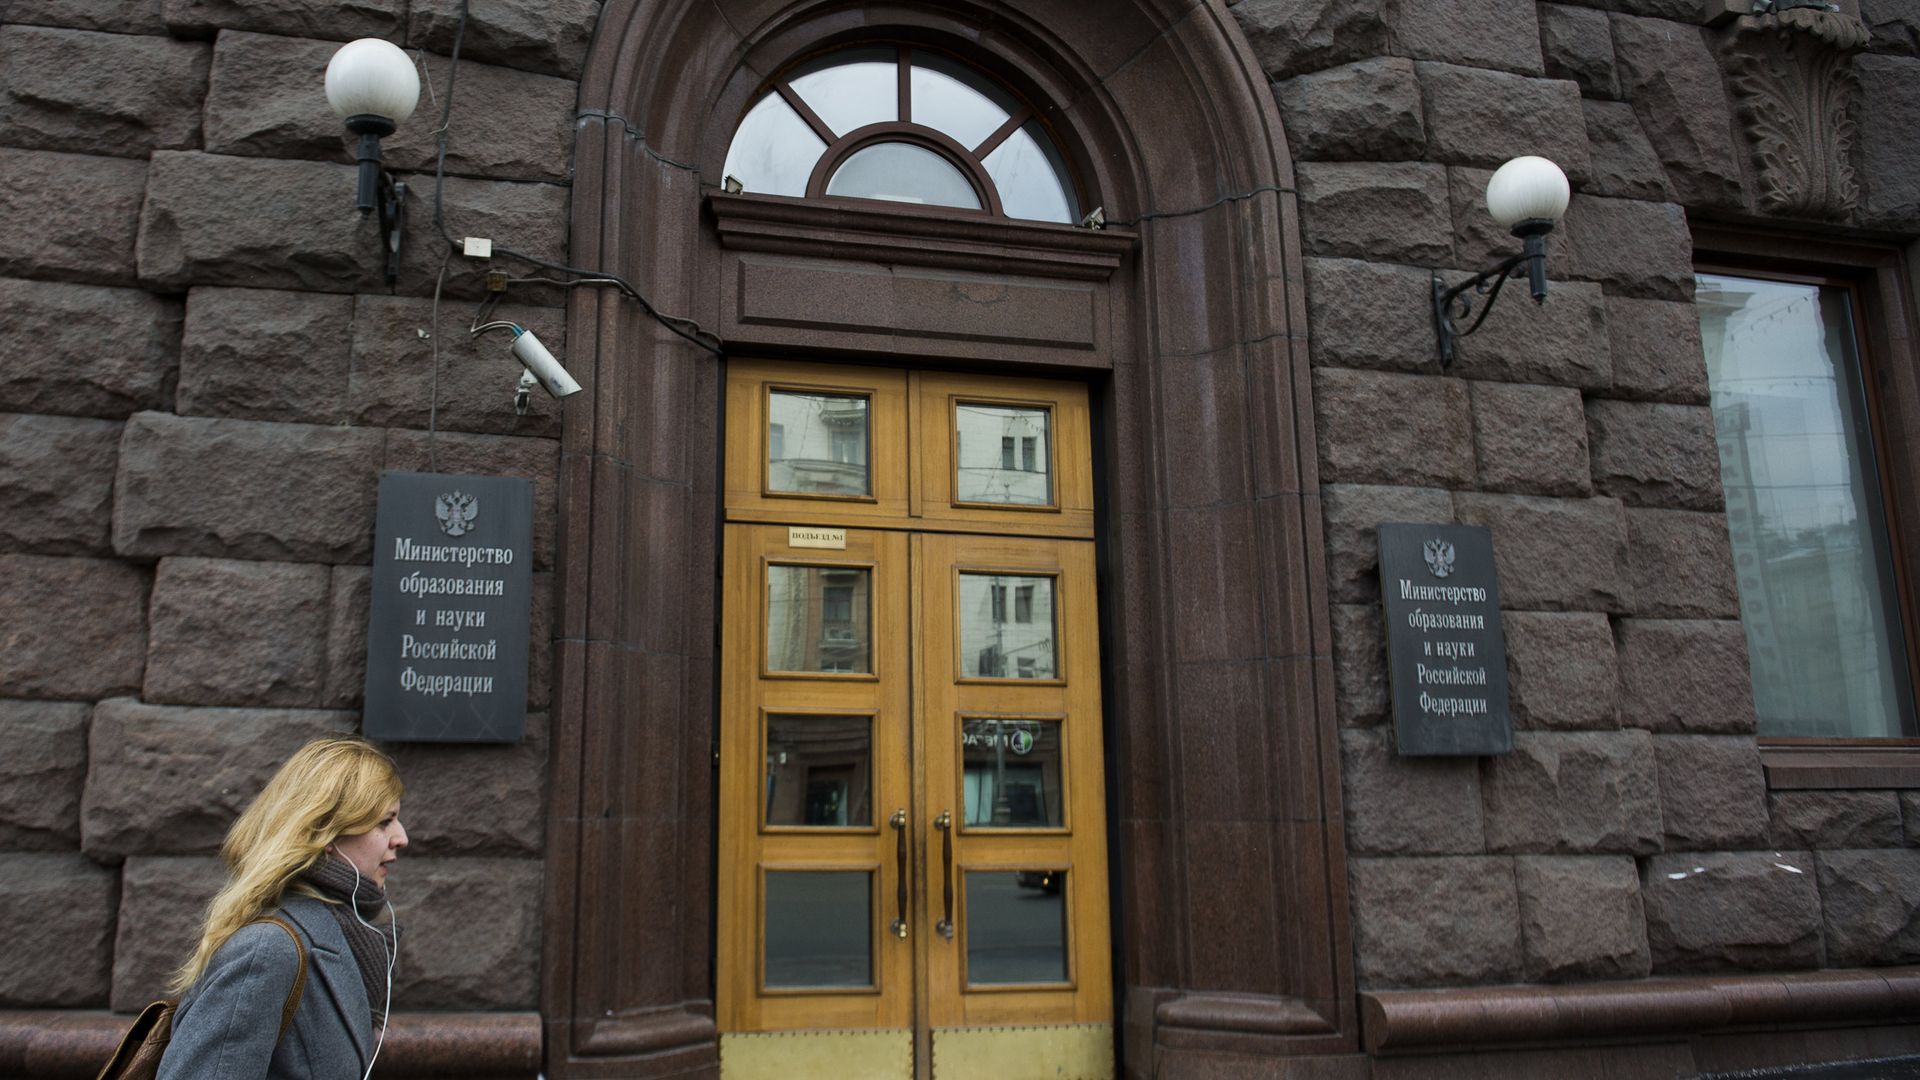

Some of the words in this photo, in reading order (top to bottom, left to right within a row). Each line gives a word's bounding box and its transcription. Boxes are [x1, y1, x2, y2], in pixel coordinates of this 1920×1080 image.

[792, 532, 830, 541] ПОДЪЕЗД
[394, 537, 513, 567] Министерство
[400, 571, 504, 597] образования
[1399, 579, 1486, 605] Министерство
[416, 609, 426, 625] и
[435, 610, 486, 631] науки
[1408, 608, 1484, 632] образования
[401, 634, 496, 660] Российской
[1424, 641, 1432, 656] и
[1436, 642, 1475, 660] науки
[400, 667, 493, 697] Федерации
[1417, 663, 1487, 685] Российской
[1419, 691, 1487, 717] Федерации
